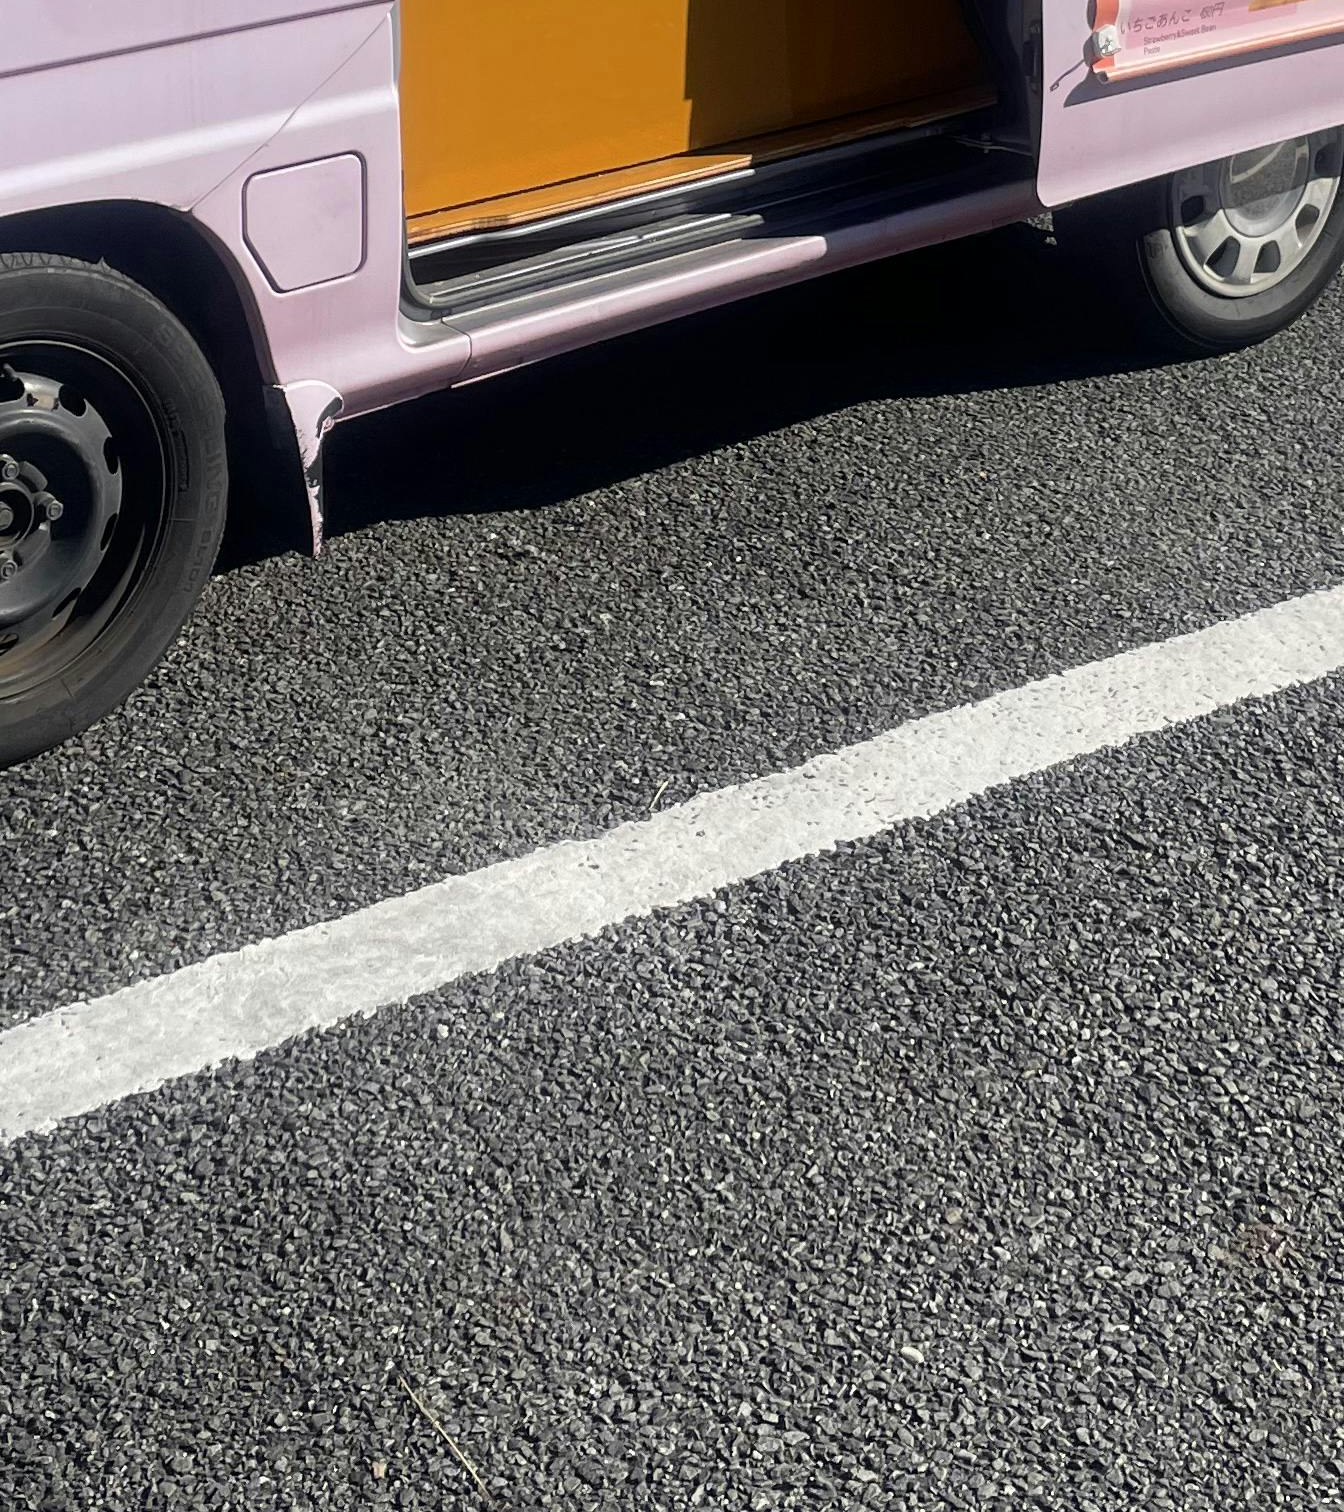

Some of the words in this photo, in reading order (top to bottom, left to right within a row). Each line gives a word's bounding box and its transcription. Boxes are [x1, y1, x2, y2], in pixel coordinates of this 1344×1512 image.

[1120, 9, 1192, 35] いちごあんこ
